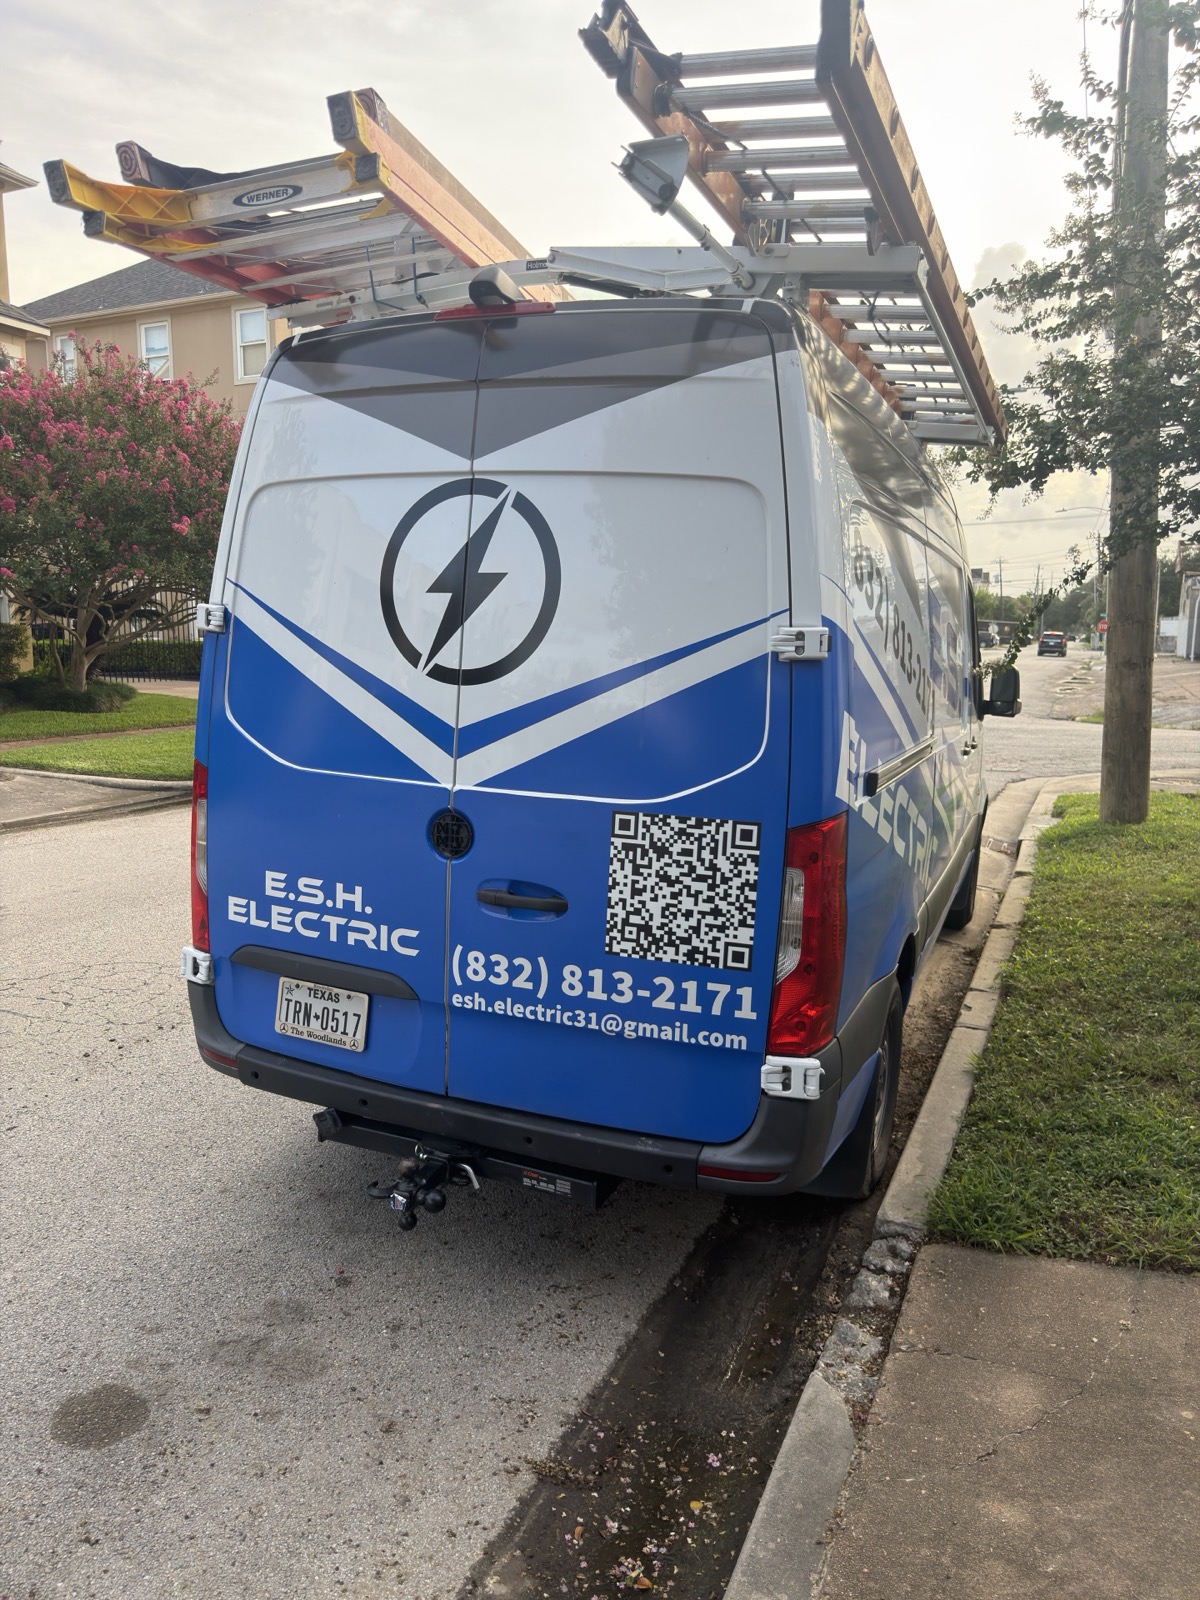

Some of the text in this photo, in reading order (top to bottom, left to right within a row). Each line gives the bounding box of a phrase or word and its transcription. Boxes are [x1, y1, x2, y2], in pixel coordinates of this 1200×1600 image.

[247, 188, 289, 203] WERNER
[265, 870, 373, 914] E.S.H.
[227, 895, 420, 957] ELECTRIC
[307, 986, 340, 1004] TEXAS
[452, 944, 757, 1020] (832) 813-2171
[290, 1026, 347, 1047] The Woodlands
[451, 992, 748, 1050] esh.electric31@gmail.com
